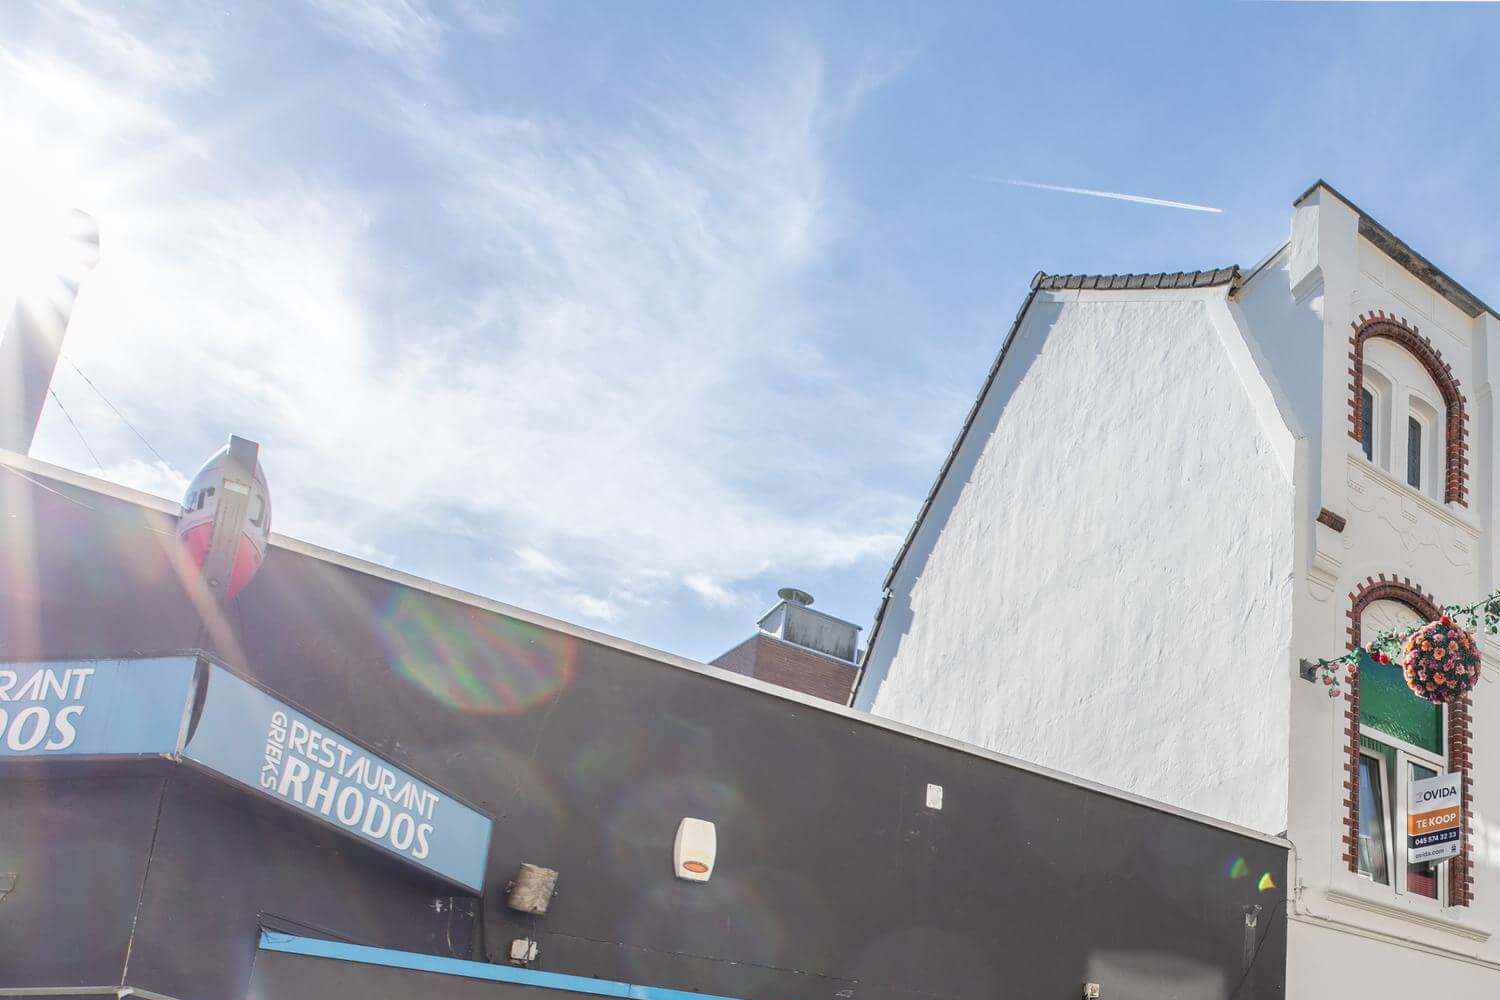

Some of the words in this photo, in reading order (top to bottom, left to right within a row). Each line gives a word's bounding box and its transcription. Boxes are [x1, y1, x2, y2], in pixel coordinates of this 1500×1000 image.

[0, 705, 85, 751] OS
[261, 711, 288, 790] GRIEKS
[278, 756, 433, 859] RHODOS
[288, 720, 439, 819] RESTAURANT
[1416, 819, 1428, 829] TE
[1429, 813, 1457, 827] KOOP
